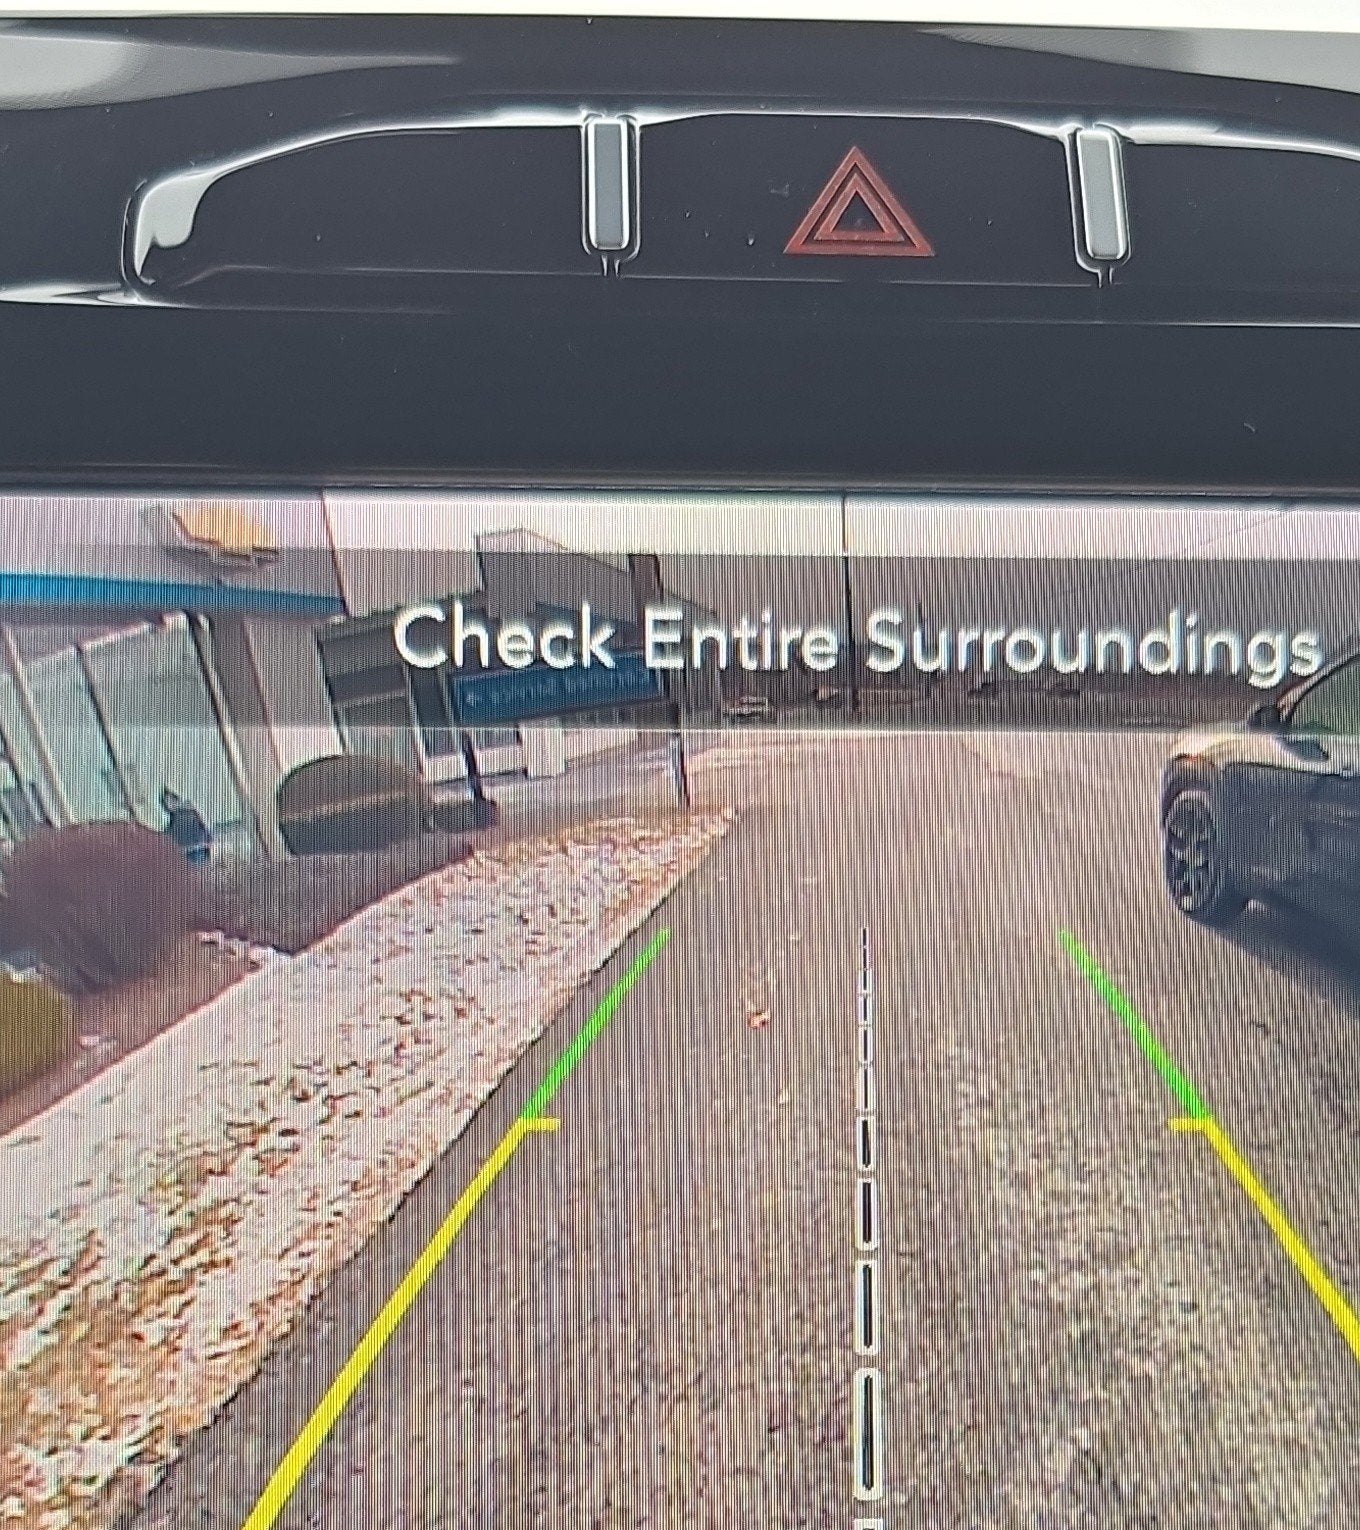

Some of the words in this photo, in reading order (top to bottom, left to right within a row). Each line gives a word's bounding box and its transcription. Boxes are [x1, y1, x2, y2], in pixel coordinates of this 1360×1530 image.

[392, 599, 617, 669] Check
[643, 604, 842, 670] Entire
[864, 607, 1323, 688] Surroundings
